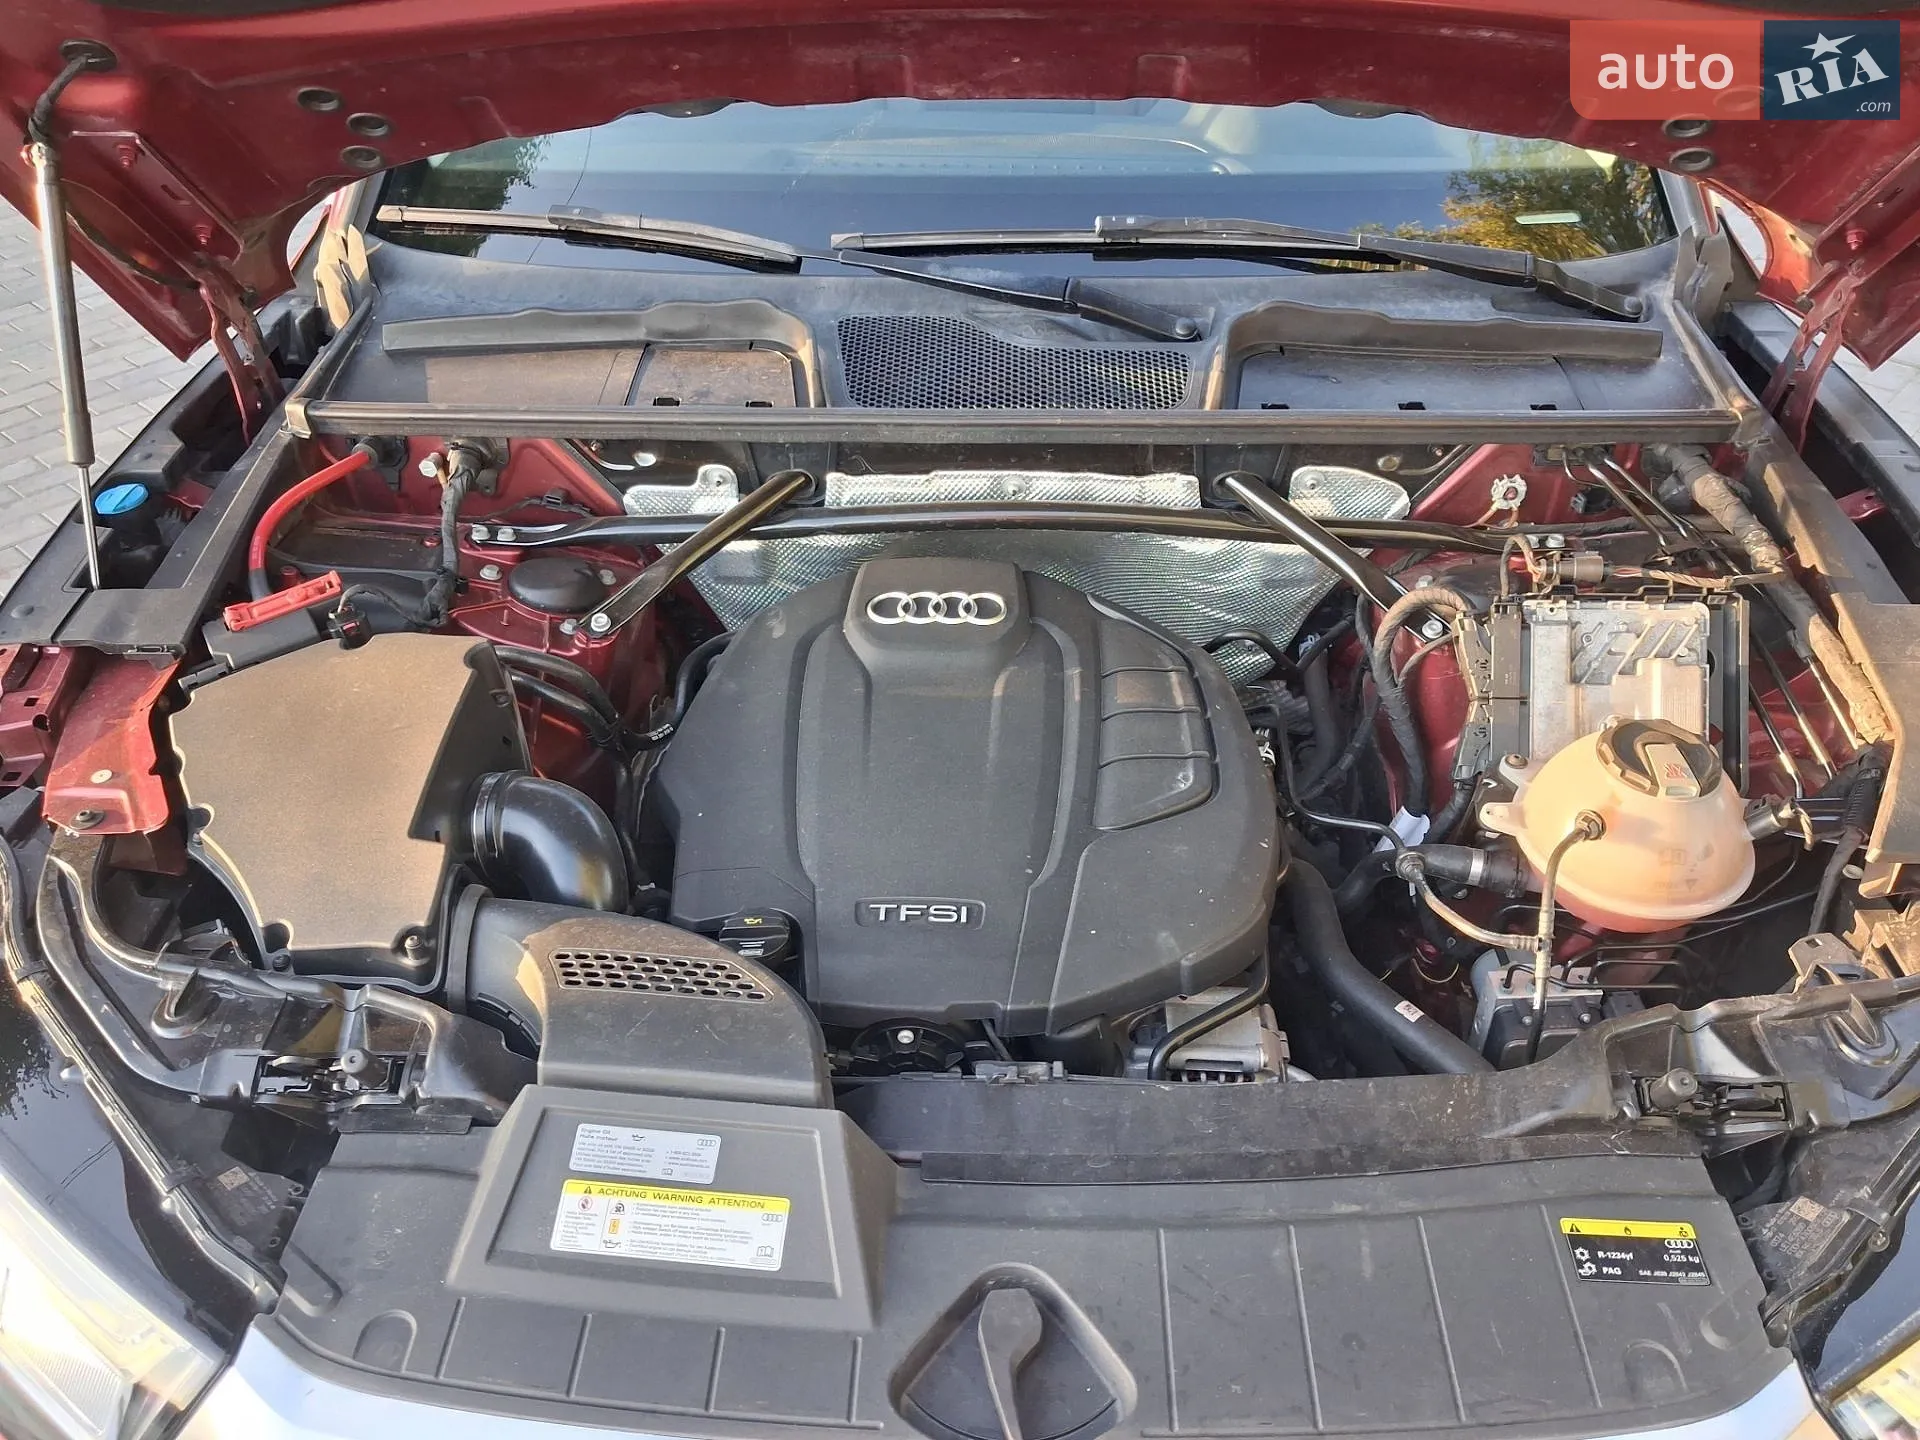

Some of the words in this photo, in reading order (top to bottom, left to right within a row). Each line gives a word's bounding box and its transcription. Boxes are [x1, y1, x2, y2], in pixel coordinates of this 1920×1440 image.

[869, 904, 968, 923] TFSI
[598, 1188, 647, 1199] ACHTUNG
[653, 1192, 704, 1204] WARNING
[708, 1197, 766, 1209] ATTENTION
[1688, 1255, 1700, 1264] kg
[1602, 1266, 1622, 1275] PAG
